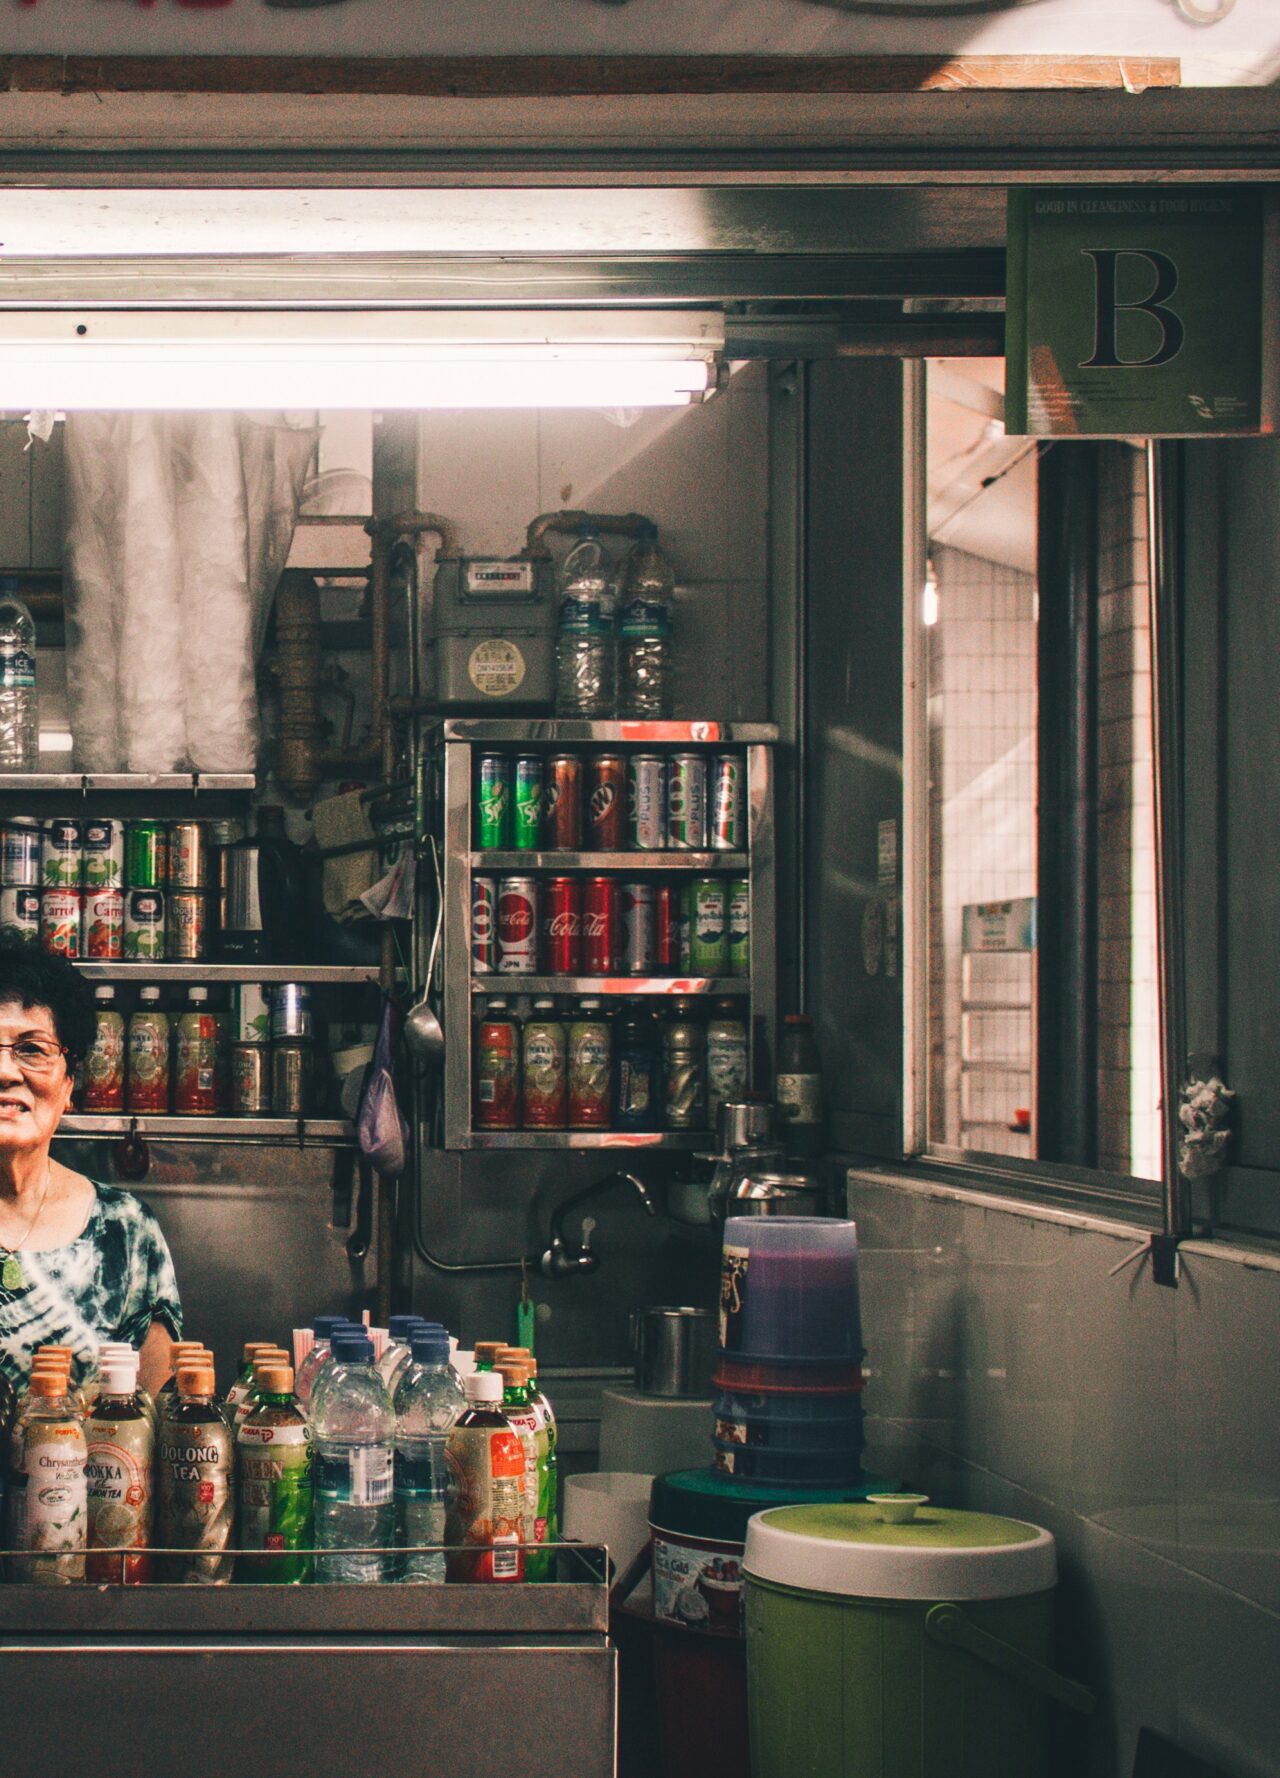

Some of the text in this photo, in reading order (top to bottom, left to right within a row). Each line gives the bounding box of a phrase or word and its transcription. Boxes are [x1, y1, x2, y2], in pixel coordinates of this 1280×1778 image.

[1035, 200, 1064, 213] GOOD
[1067, 200, 1078, 213] IN
[1081, 199, 1146, 213] CLEANLINESS
[1159, 199, 1188, 213] FOOD
[1078, 247, 1186, 369] B
[15, 659, 29, 667] ICE
[41, 902, 76, 917] Carrot
[503, 960, 521, 969] JPN
[161, 1443, 219, 1463] OOLONG
[171, 1463, 200, 1481] TEA
